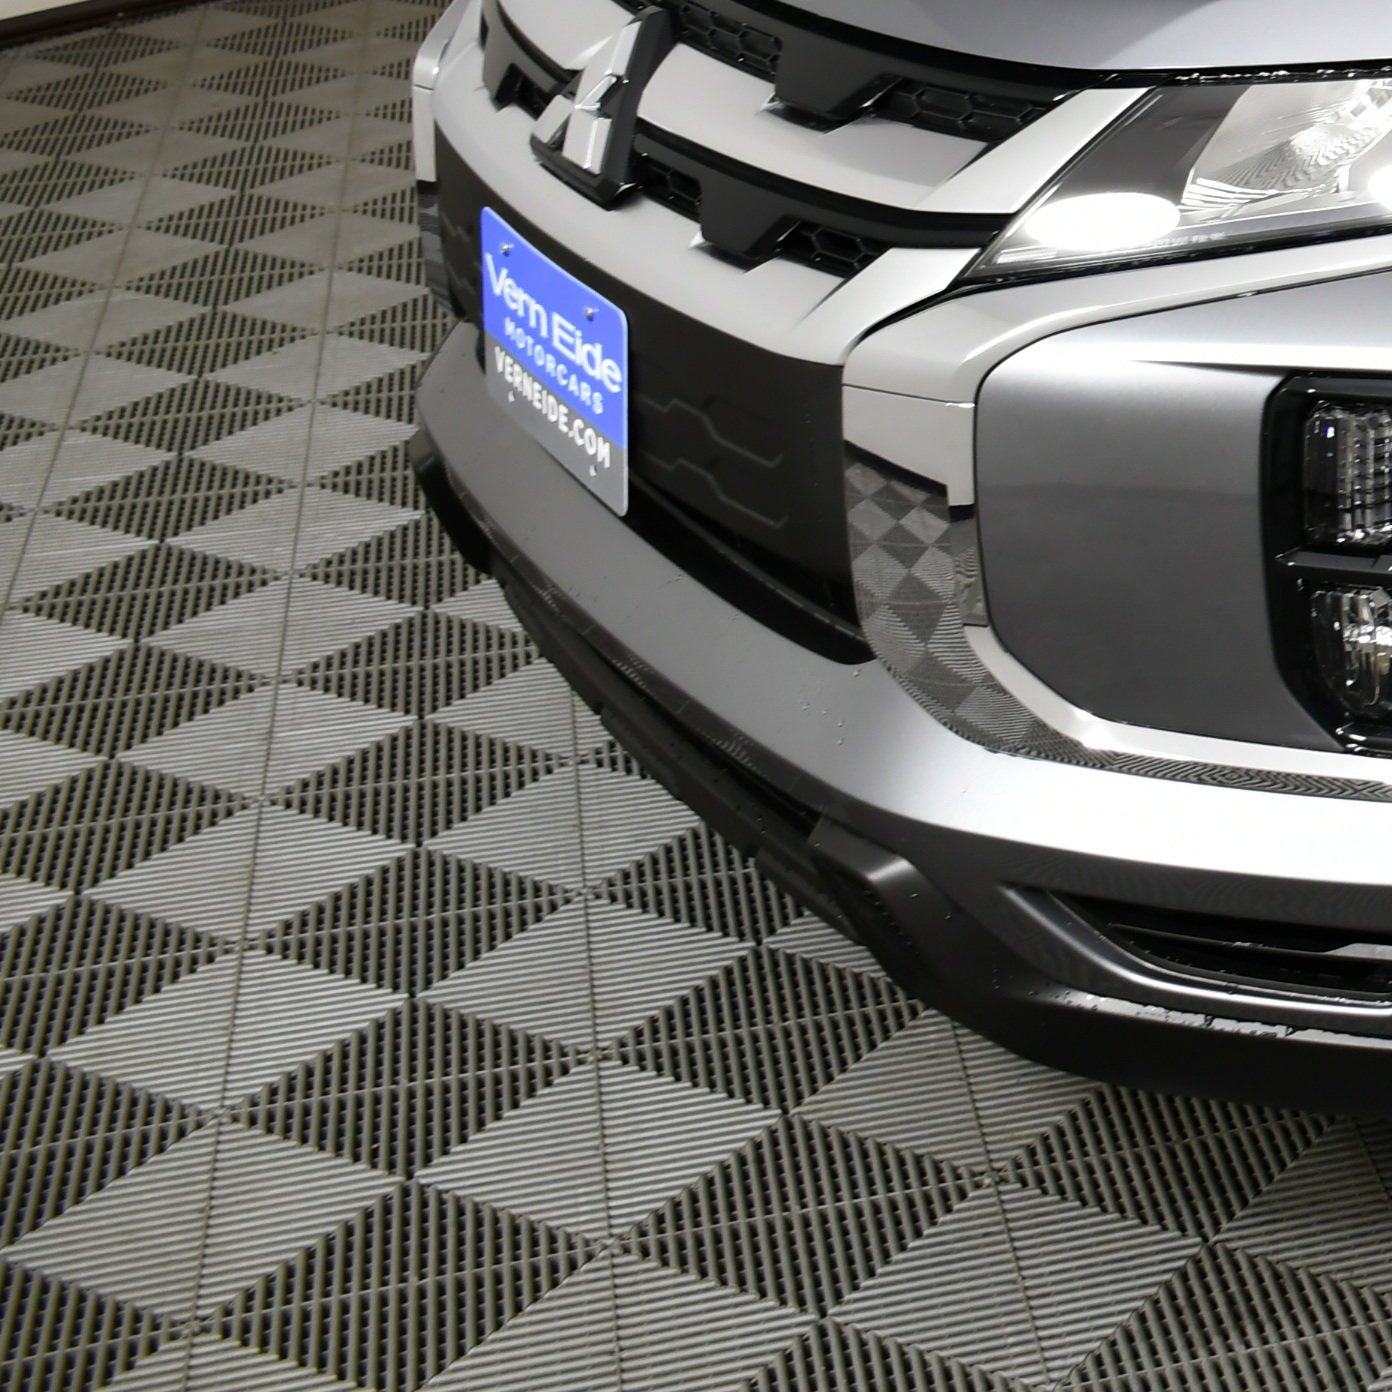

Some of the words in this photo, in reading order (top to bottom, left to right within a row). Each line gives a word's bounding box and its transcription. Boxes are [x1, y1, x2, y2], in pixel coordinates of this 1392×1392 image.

[485, 252, 548, 339] Vern
[552, 311, 622, 393] Eide
[504, 316, 604, 415] MOTORCARS
[494, 346, 611, 469] VERNEIDE.COM
